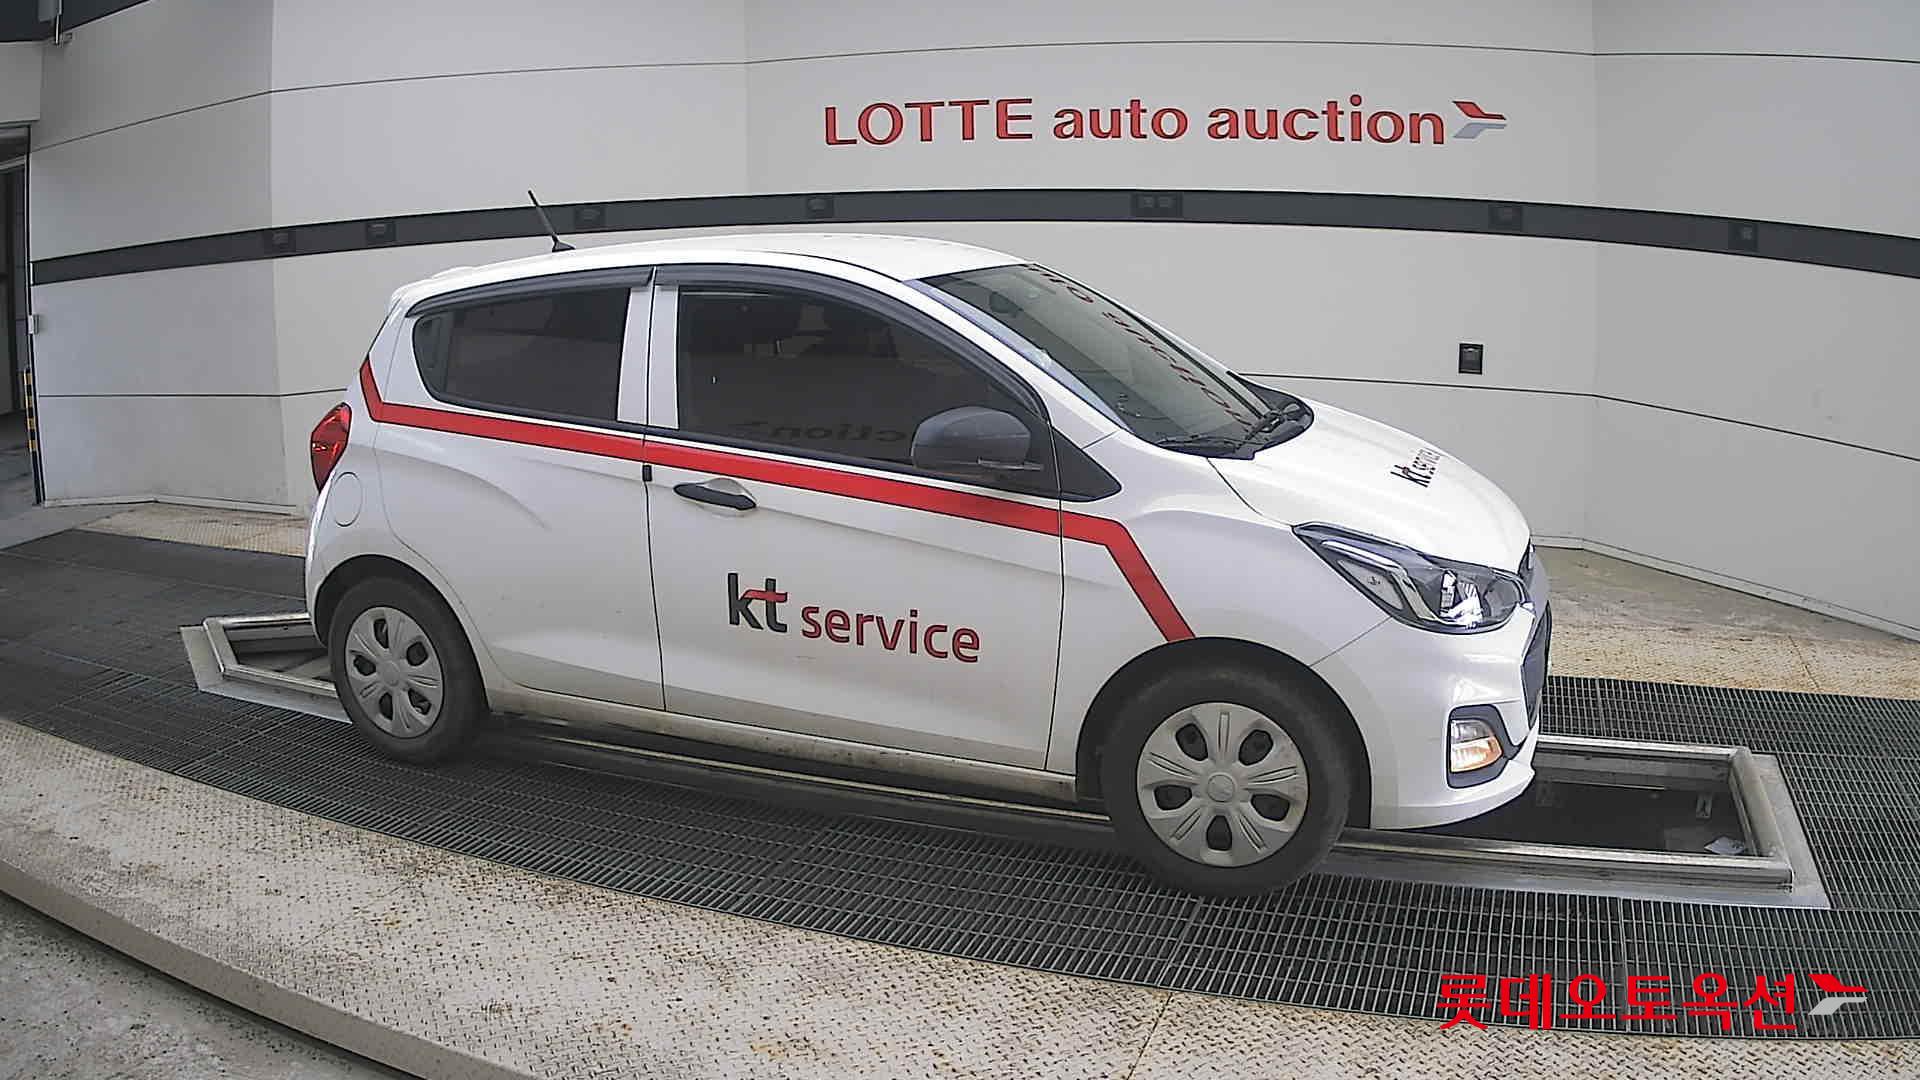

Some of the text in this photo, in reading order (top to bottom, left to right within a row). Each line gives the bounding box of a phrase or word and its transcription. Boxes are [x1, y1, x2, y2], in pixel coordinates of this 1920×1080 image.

[825, 95, 1445, 145] LOTTE auto auction
[727, 572, 981, 662] kt service
